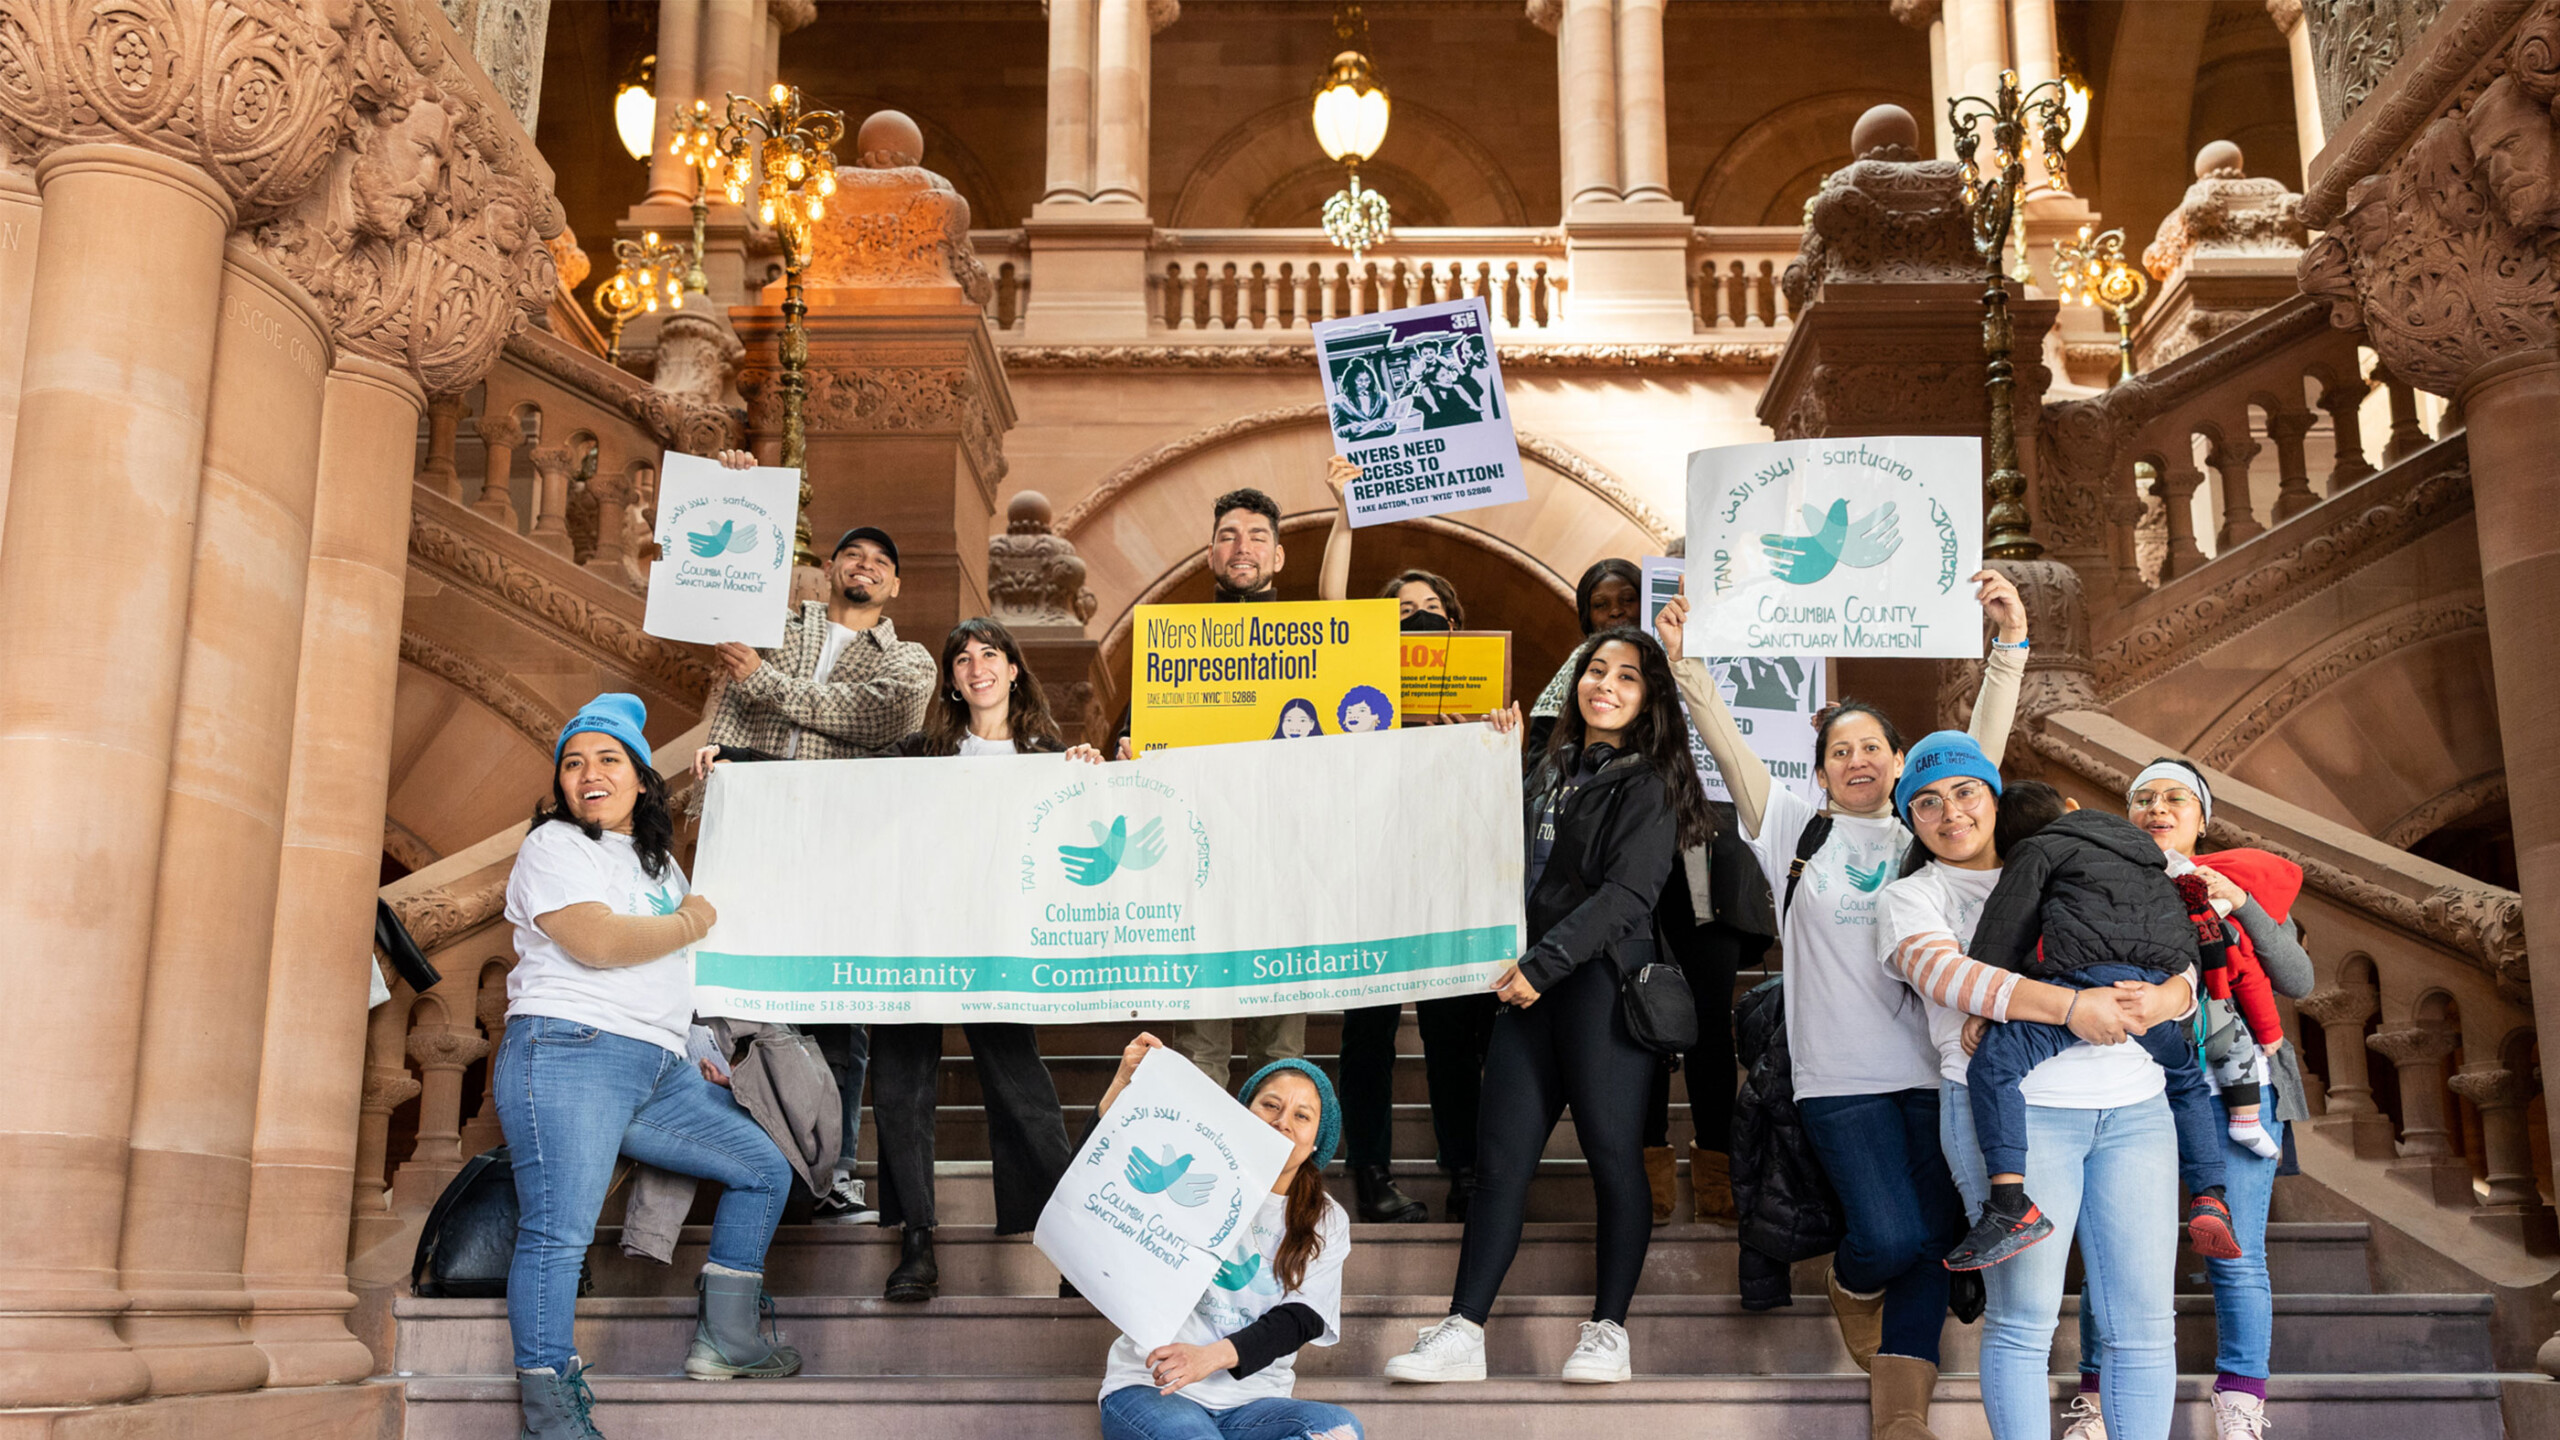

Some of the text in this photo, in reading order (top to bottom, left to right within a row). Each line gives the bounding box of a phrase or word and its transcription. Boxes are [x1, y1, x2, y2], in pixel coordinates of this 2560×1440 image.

[1450, 313, 1468, 330] 35
[1346, 438, 1446, 466] NYERS NEED
[1418, 456, 1440, 472] TO
[1823, 444, 1912, 482] santuario
[1353, 463, 1504, 500] REPRESENTATION!
[722, 496, 766, 516] santuario
[1357, 504, 1376, 514] TAKE
[1378, 499, 1410, 512] ACTION,
[1411, 496, 1430, 506] TEXT
[1456, 490, 1466, 498] TO
[1467, 486, 1492, 496] 52886
[1714, 549, 1733, 596] TAND
[1147, 616, 1350, 648] NYers Need Access to
[1146, 648, 1317, 688] Representation!
[1147, 692, 1160, 704] TAKE
[1232, 691, 1256, 704] 52886
[1915, 752, 1942, 774] CARE
[1107, 769, 1176, 798] santuario
[1022, 854, 1036, 894] TAND
[1045, 901, 1182, 923] Columbia County
[1030, 925, 1196, 949] Sanctuary Movement
[832, 948, 1388, 990] Humanity Community Solidarity
[1238, 971, 1488, 1005] www.facebook.com/sanctuarycocounty
[765, 999, 815, 1012] Hotline
[820, 1000, 911, 1012] 518-303-3848
[960, 998, 1190, 1014] www.sanctuarycolumbiacounty.org
[1087, 1136, 1110, 1168] TAND
[1195, 1122, 1239, 1171] santuario
